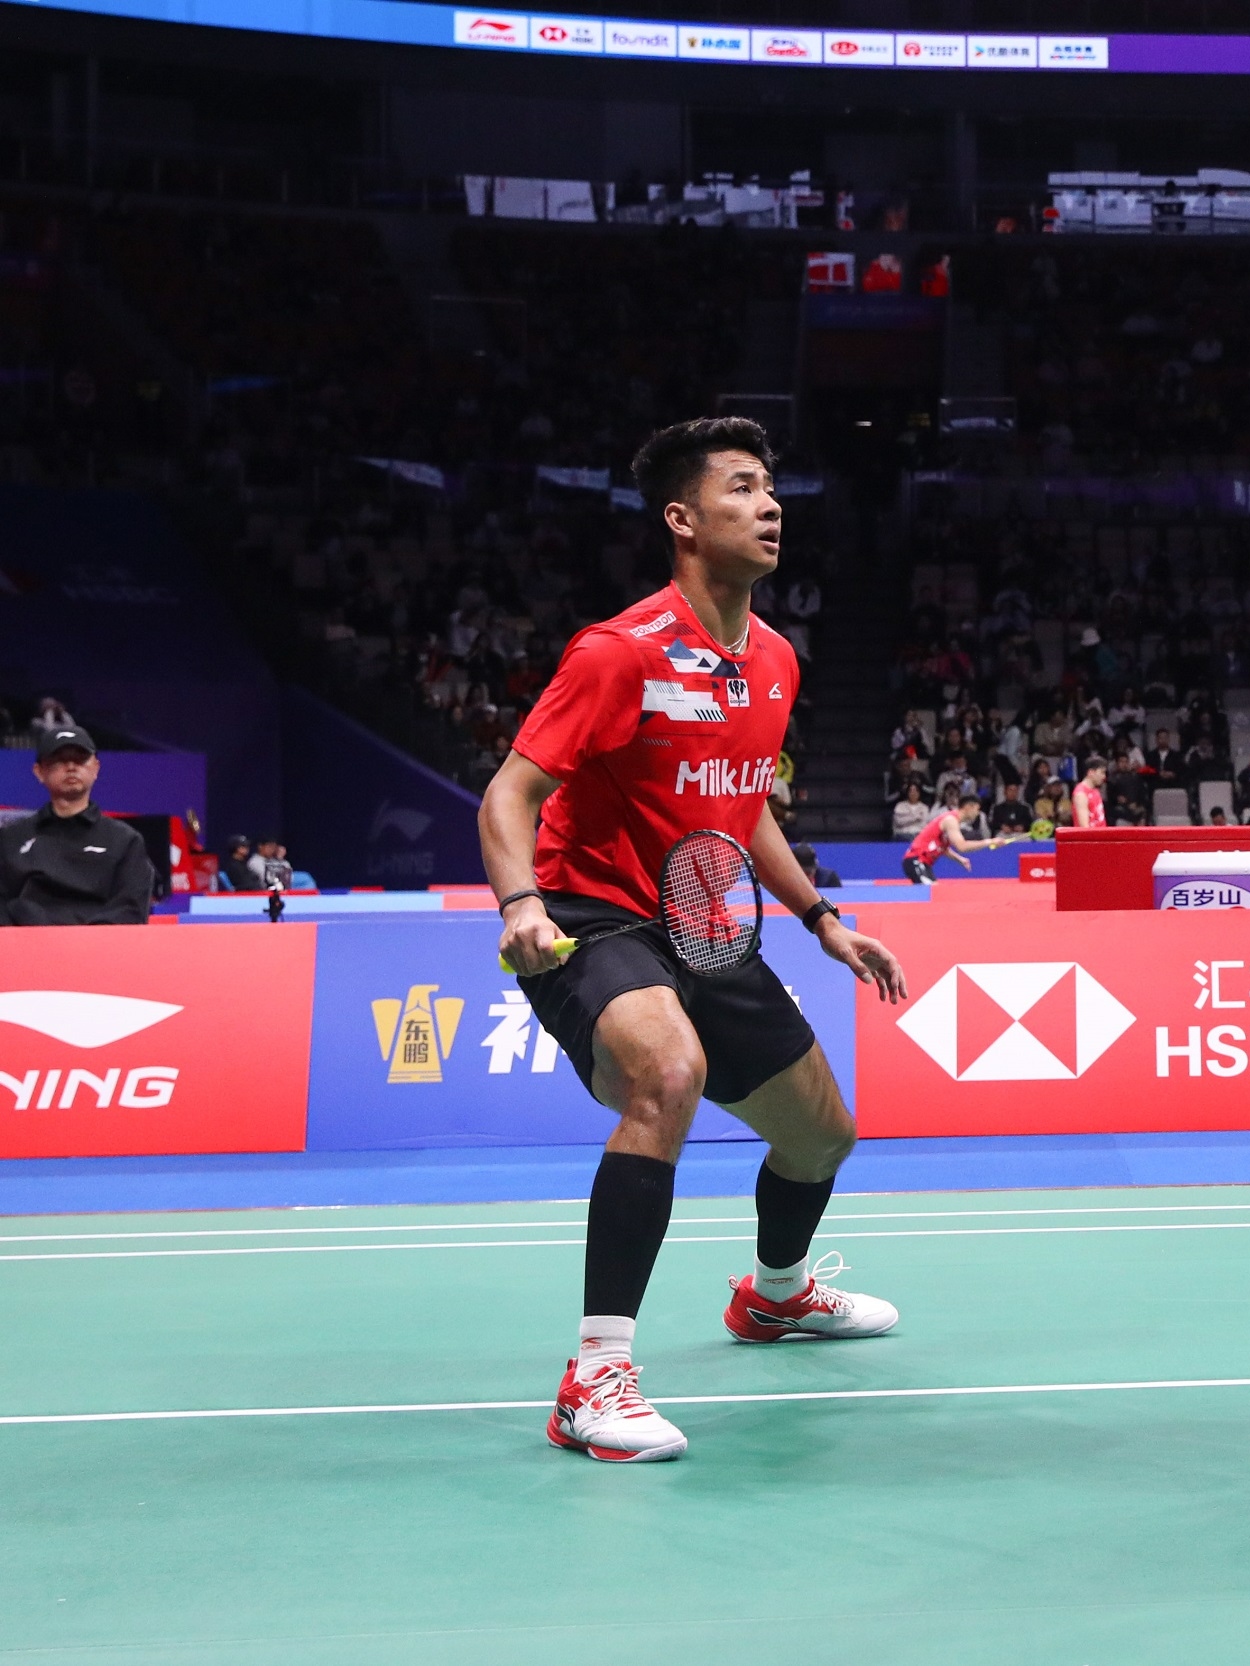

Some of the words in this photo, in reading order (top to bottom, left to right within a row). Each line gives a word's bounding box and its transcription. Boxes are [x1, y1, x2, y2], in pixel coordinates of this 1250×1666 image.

[612, 33, 669, 48] foundit
[632, 613, 675, 636] POLYTRON
[1172, 889, 1240, 906] 百岁山
